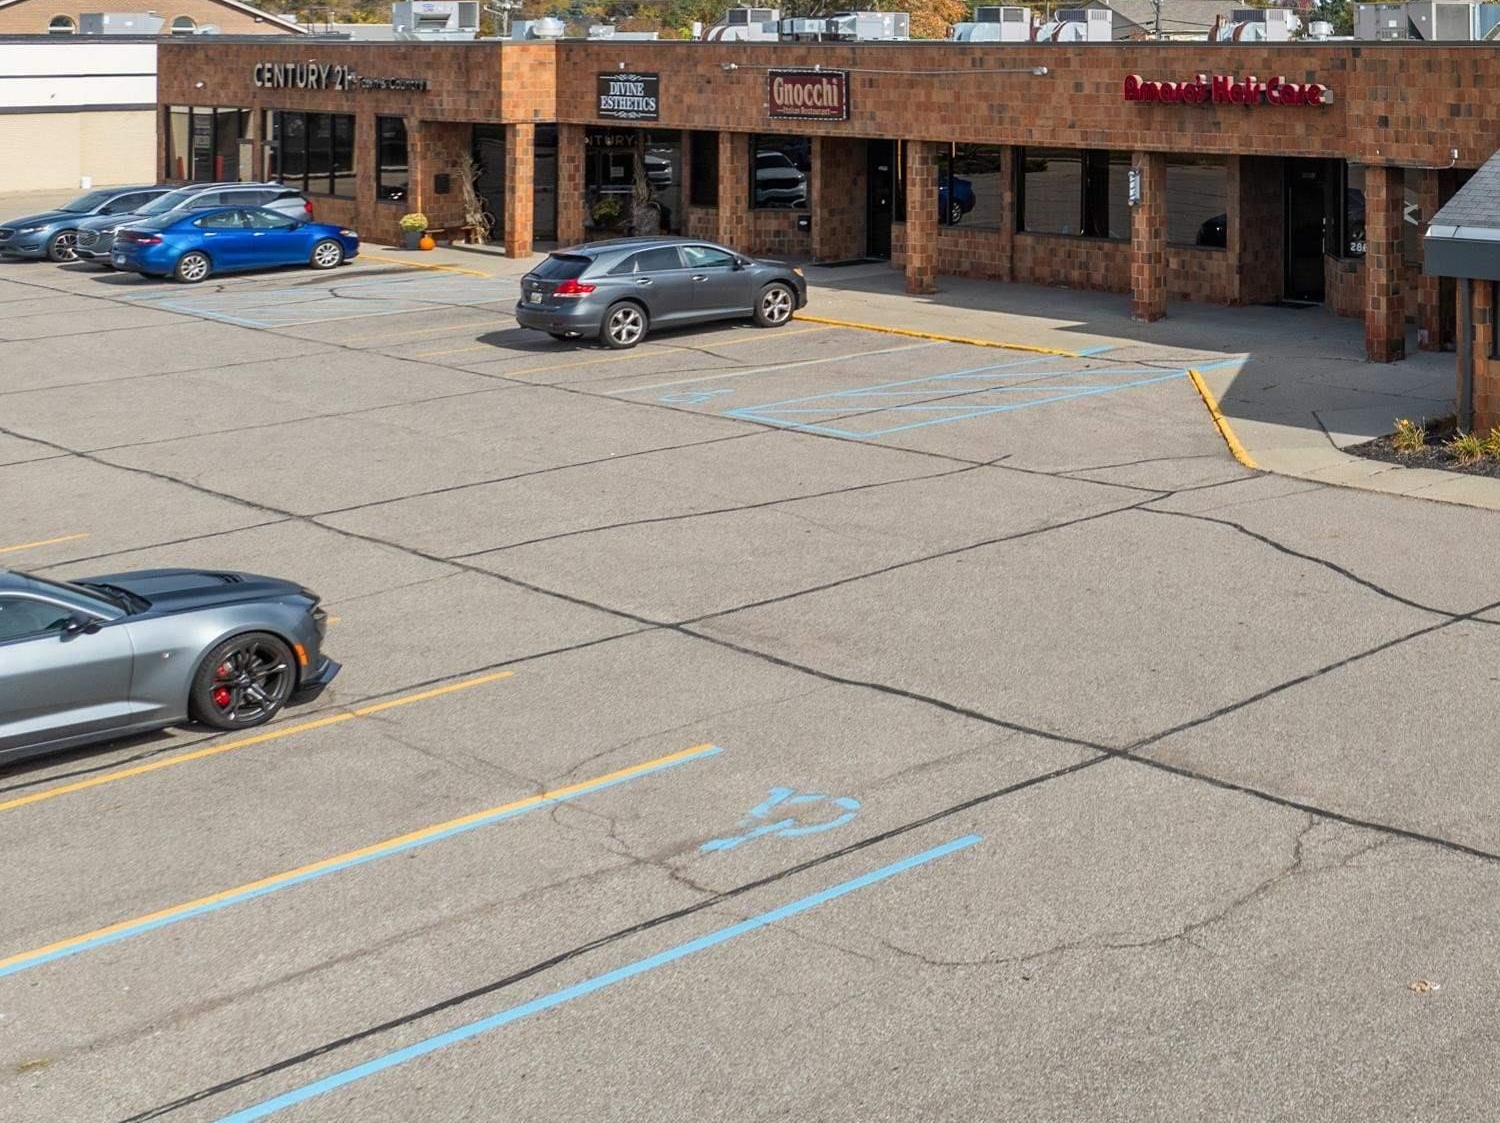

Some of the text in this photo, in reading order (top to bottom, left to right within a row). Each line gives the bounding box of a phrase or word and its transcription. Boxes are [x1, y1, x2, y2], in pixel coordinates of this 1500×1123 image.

[254, 62, 330, 89] CENTURY
[334, 64, 349, 91] 21
[609, 82, 644, 95] DIVINE
[773, 77, 838, 107] Gnocchi
[1211, 75, 1264, 105] Hair
[1266, 76, 1325, 106] Care
[600, 96, 656, 111] ESTHETICS
[584, 134, 635, 146] NTURY
